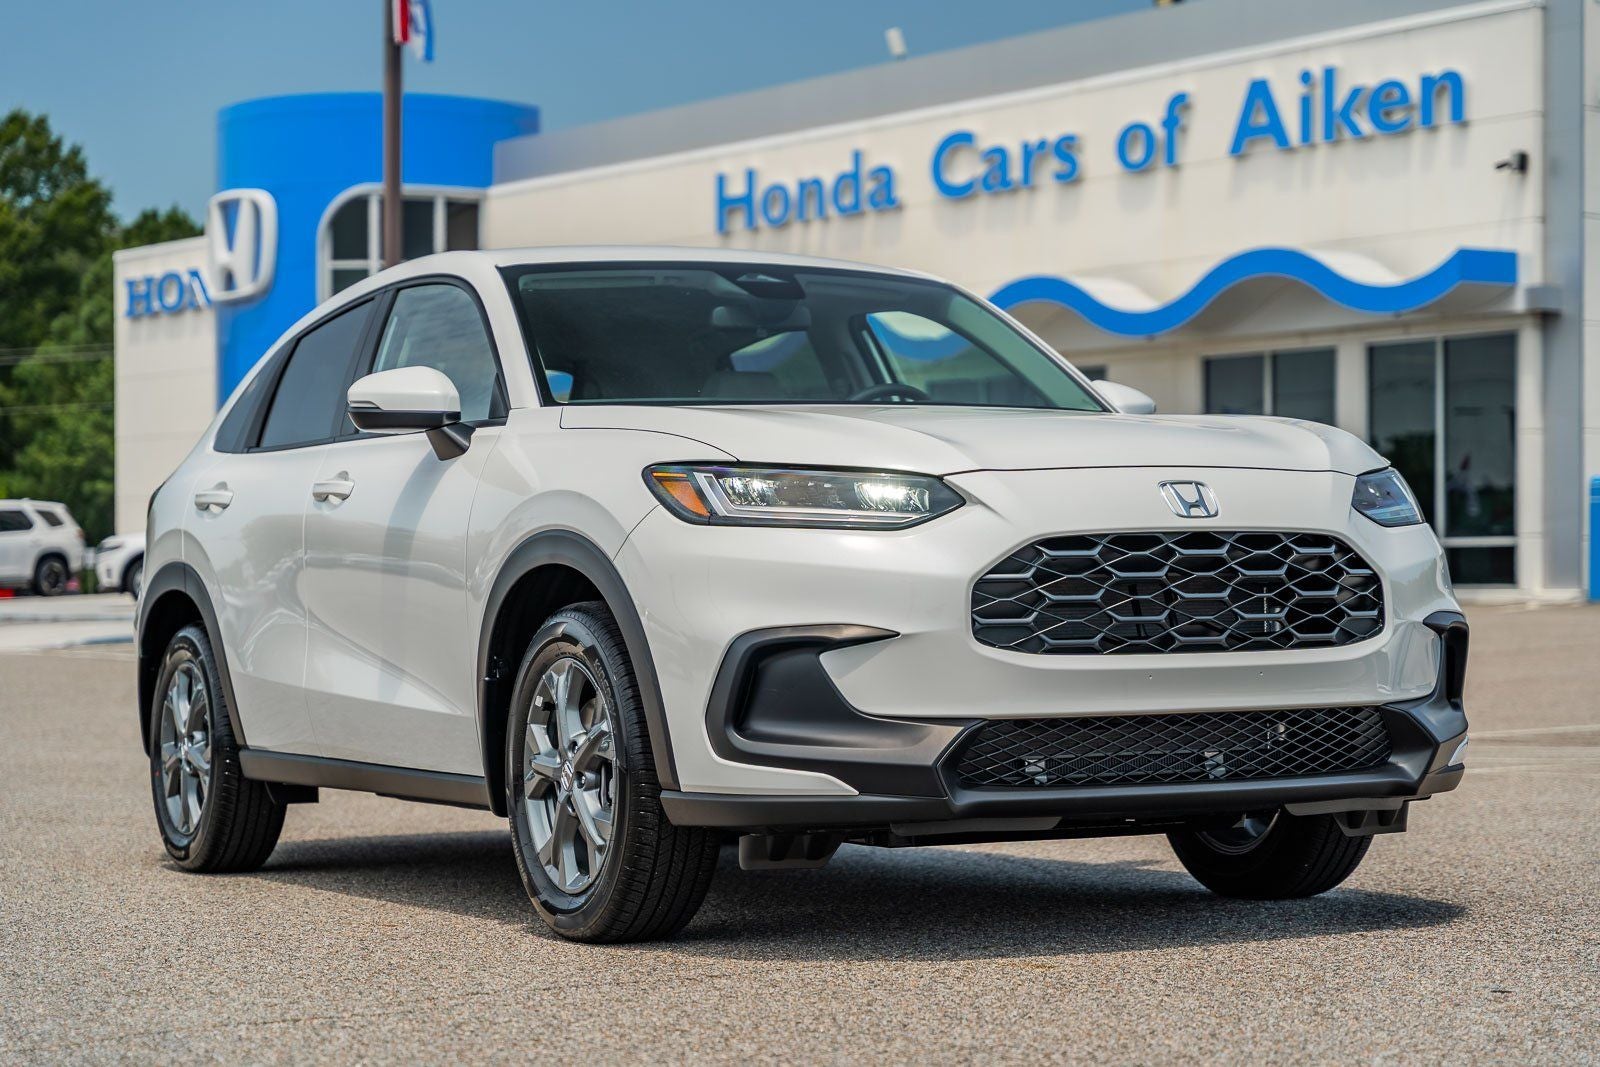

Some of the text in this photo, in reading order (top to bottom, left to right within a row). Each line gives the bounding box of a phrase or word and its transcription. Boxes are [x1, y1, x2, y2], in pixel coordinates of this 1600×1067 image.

[715, 65, 1465, 234] Honda Cars of Aiken
